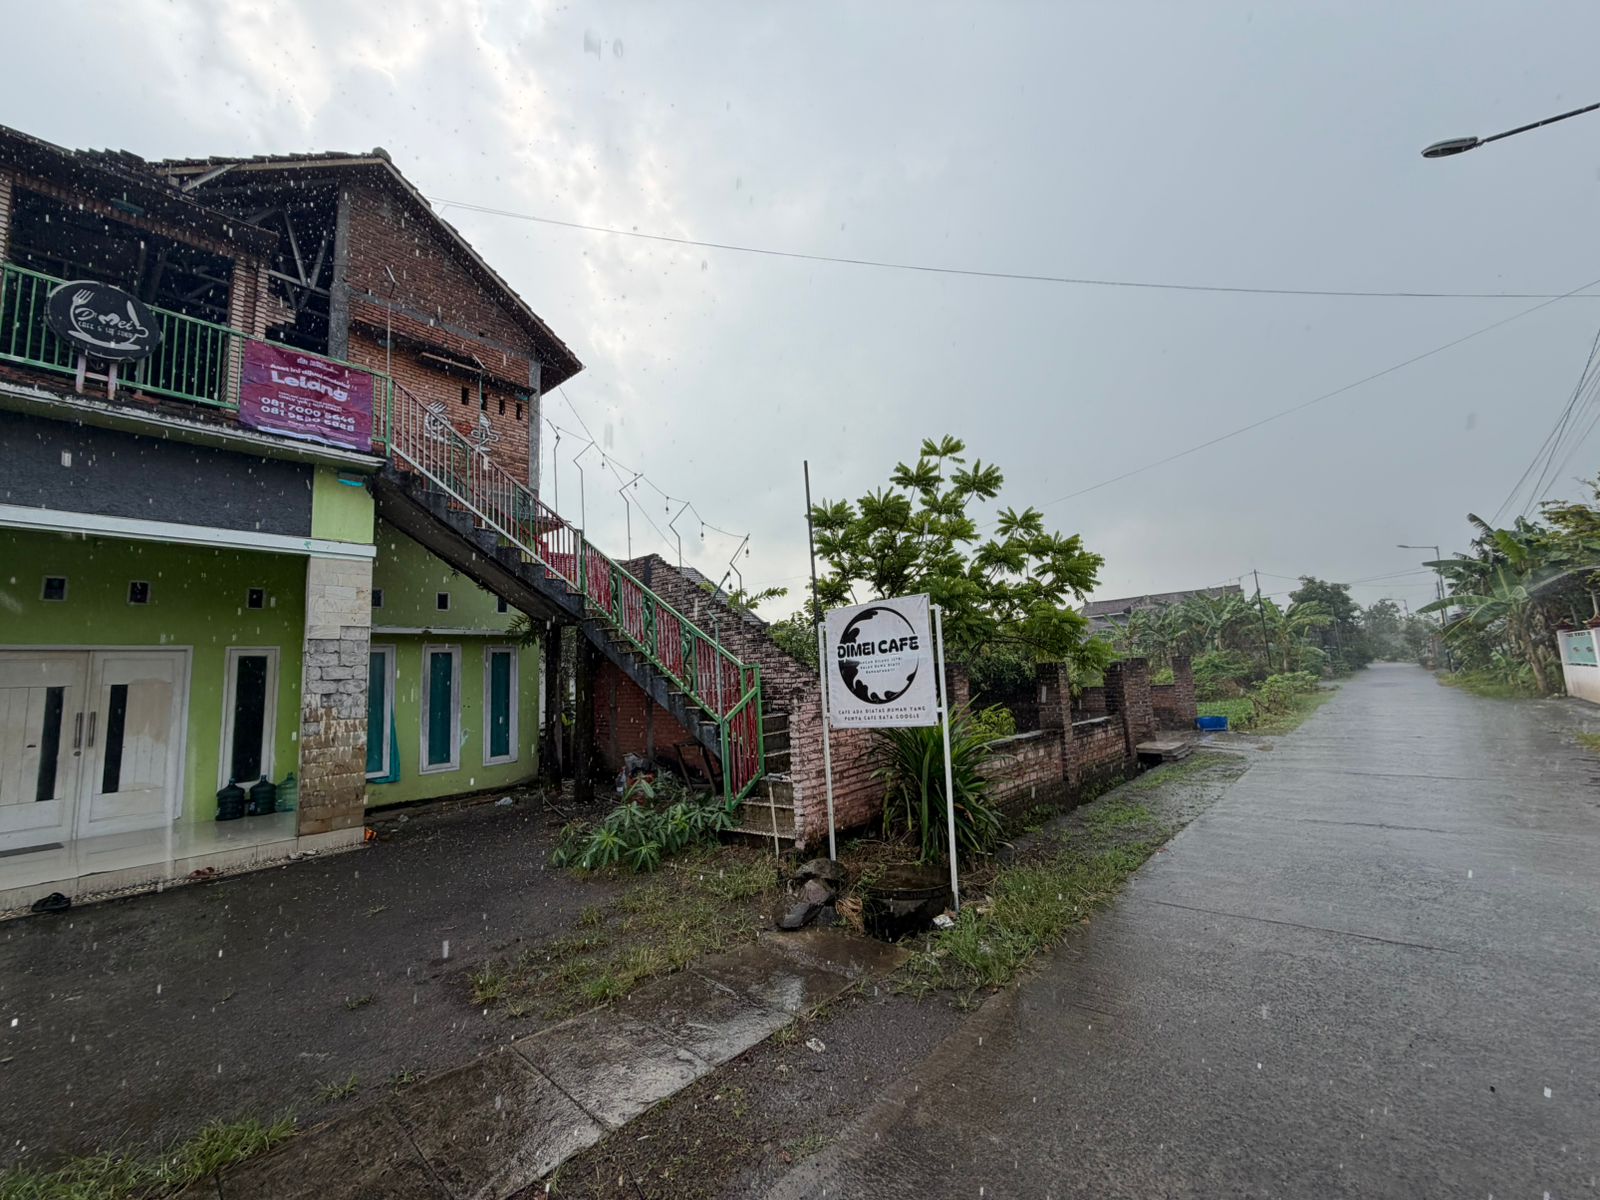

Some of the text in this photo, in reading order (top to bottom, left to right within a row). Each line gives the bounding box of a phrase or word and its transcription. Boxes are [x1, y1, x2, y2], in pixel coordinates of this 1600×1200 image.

[271, 370, 348, 402] Lelang
[261, 397, 285, 409] 081
[288, 403, 321, 417] 7000
[261, 405, 285, 417] 081
[837, 636, 920, 659] DIMEI CAFE
